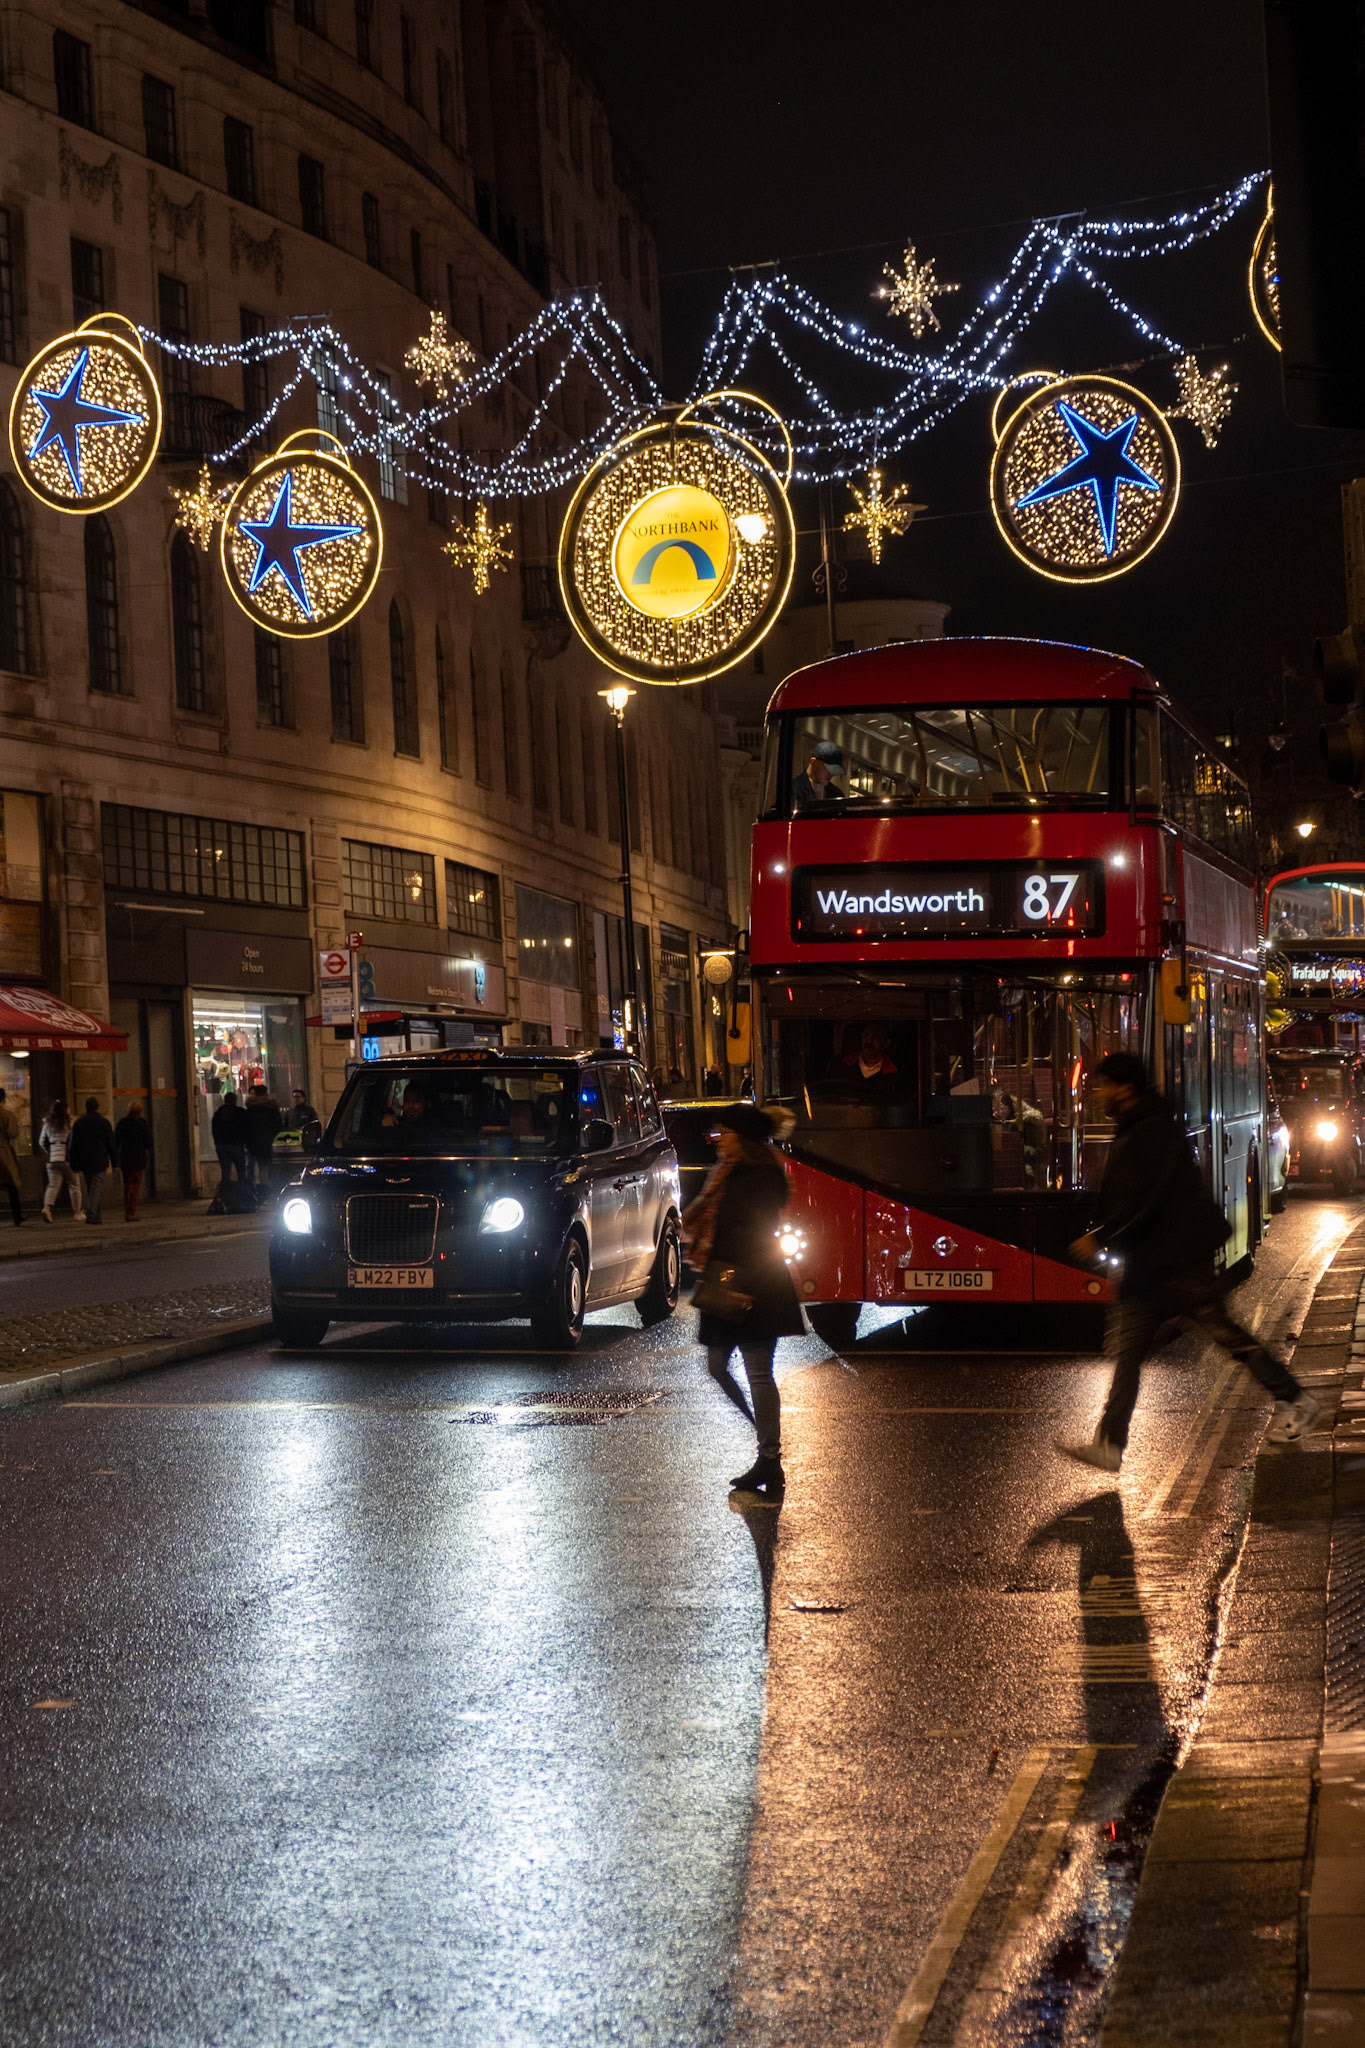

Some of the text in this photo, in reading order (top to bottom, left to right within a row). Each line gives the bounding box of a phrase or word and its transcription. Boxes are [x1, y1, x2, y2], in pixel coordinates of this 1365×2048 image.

[629, 519, 719, 539] NORTHBANK
[816, 874, 1079, 920] Wandsworth 87
[349, 933, 359, 947] E
[244, 946, 260, 960] Open
[241, 961, 265, 973] 24 hours
[1292, 966, 1361, 983] Trafalgar Square
[441, 1051, 488, 1061] TAXI
[354, 1270, 427, 1284] LM22 FBY
[914, 1272, 983, 1287] LTZ 1060
